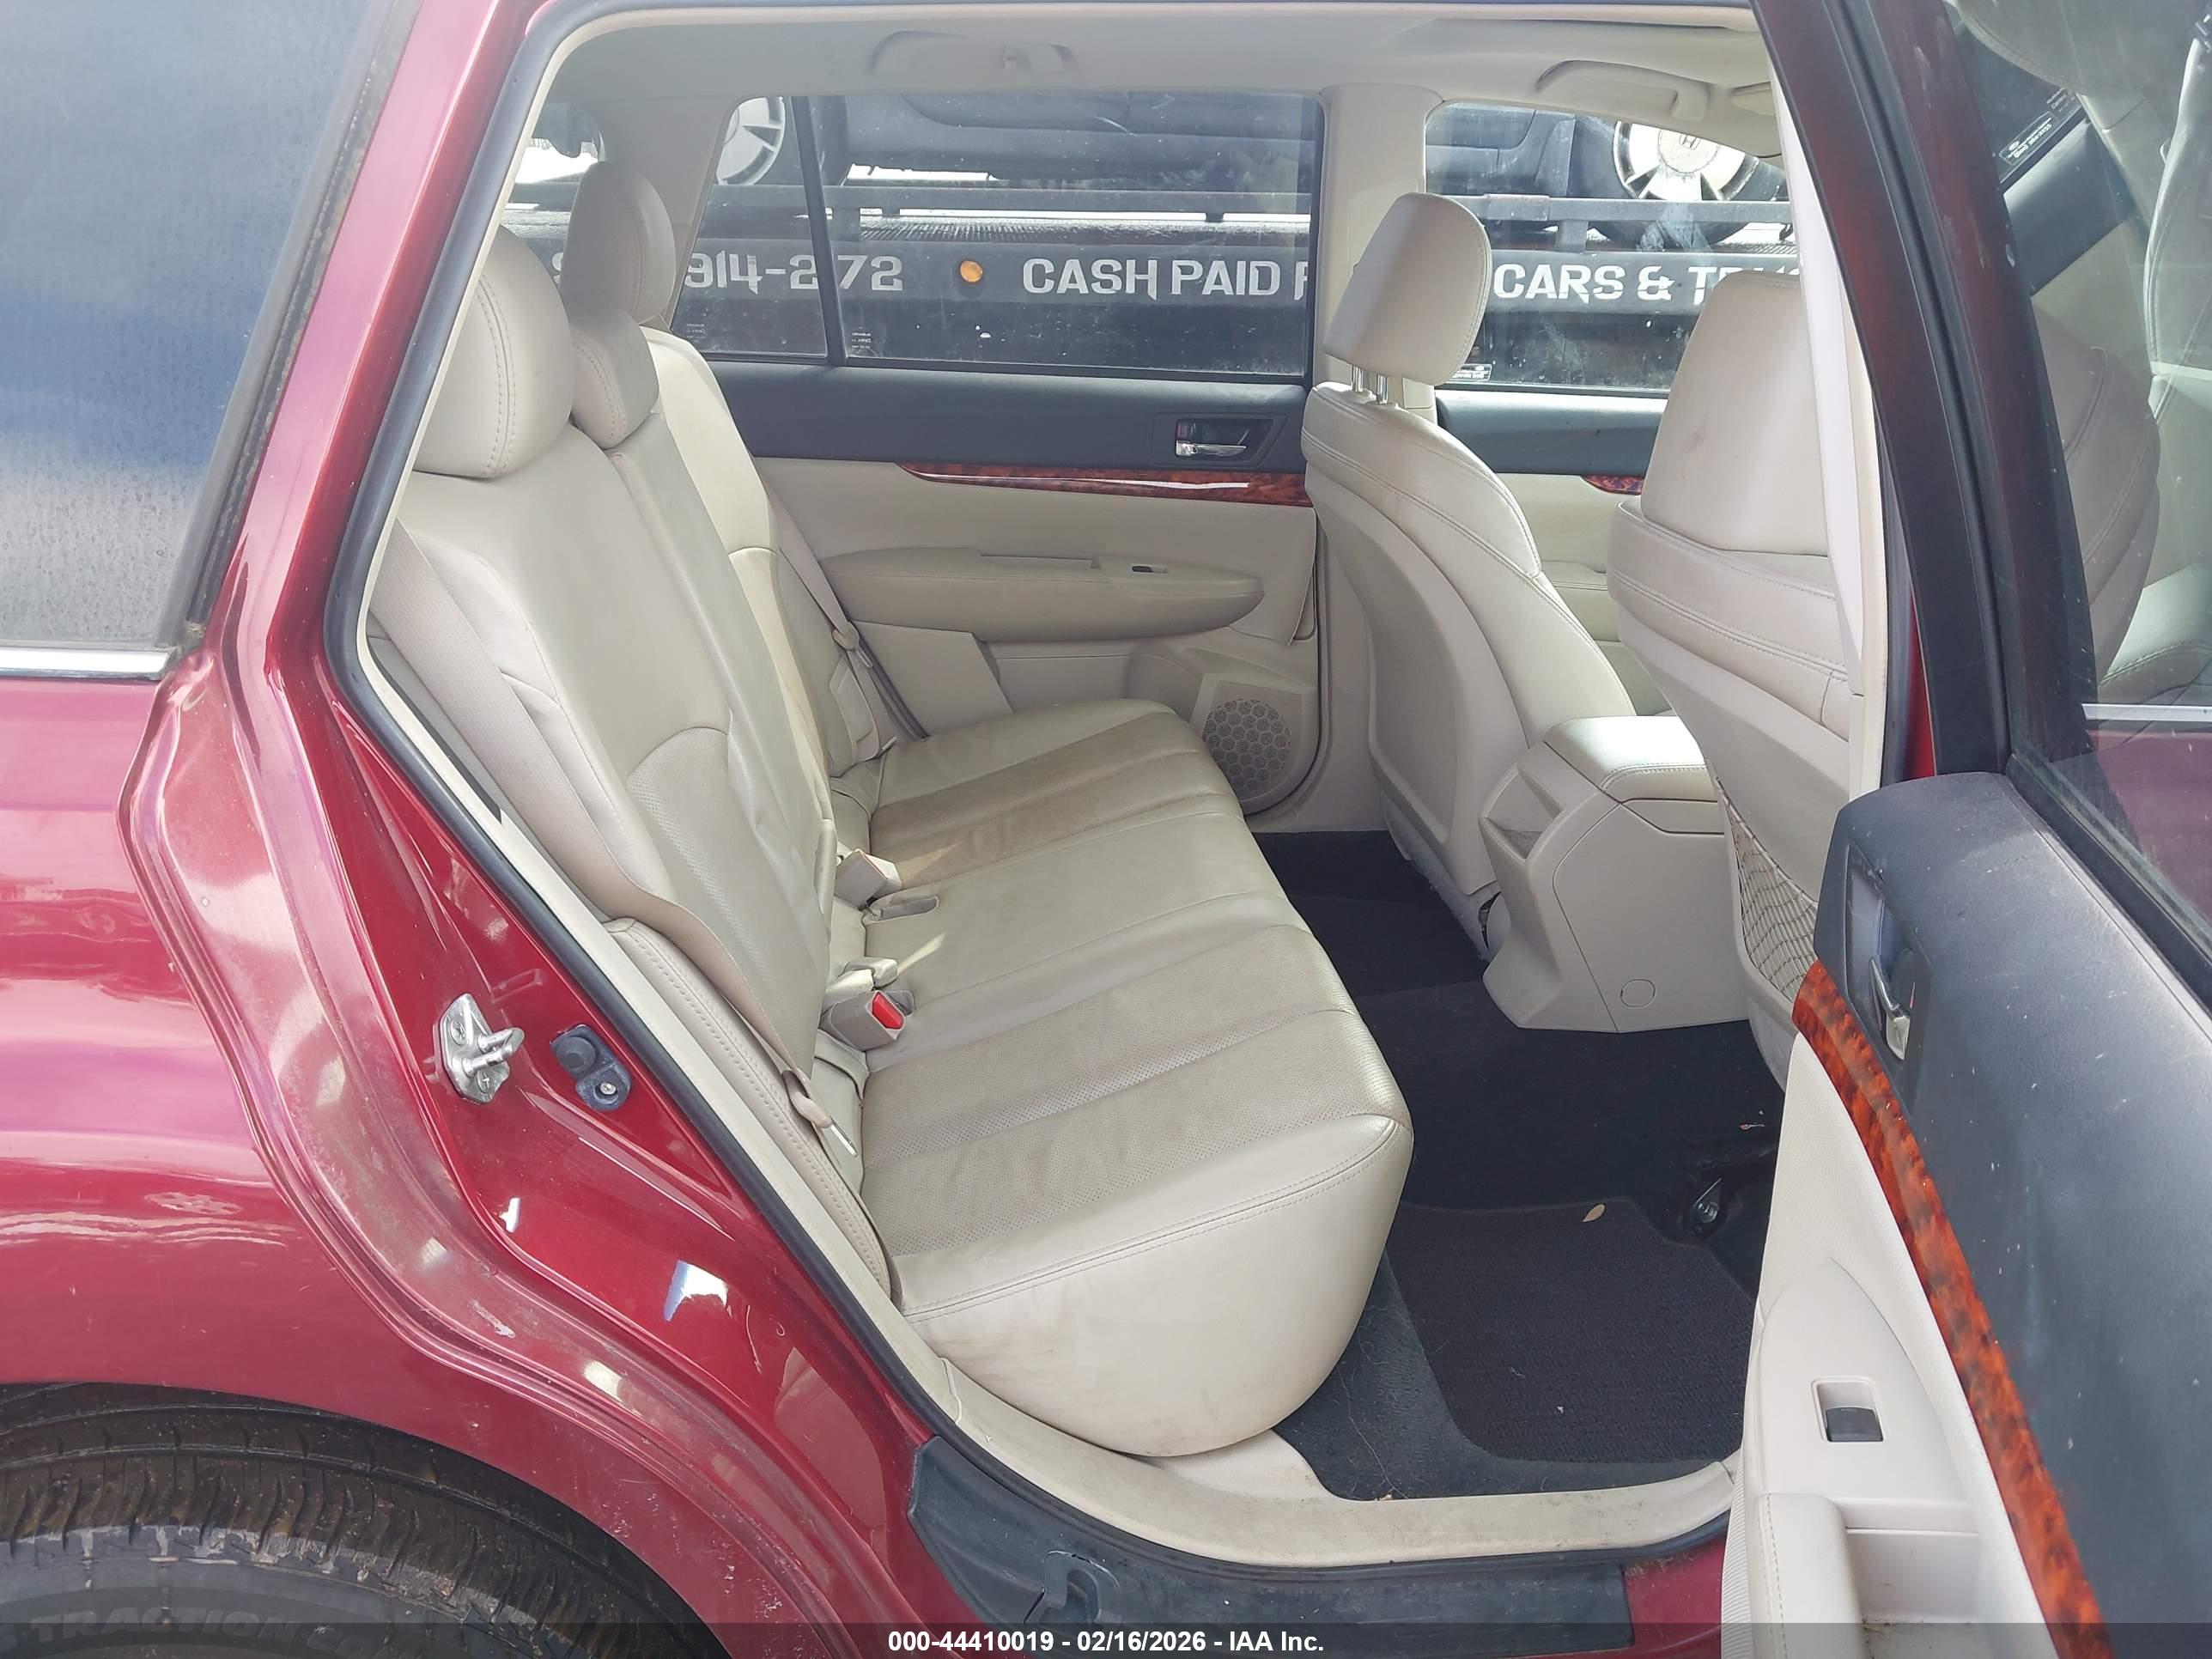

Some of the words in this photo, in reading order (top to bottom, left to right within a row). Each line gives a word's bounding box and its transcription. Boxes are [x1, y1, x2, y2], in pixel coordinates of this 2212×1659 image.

[1023, 258, 1158, 301] CASH
[1170, 260, 1281, 296] PAID
[1492, 263, 1626, 304] CARS
[1638, 265, 1675, 301] &
